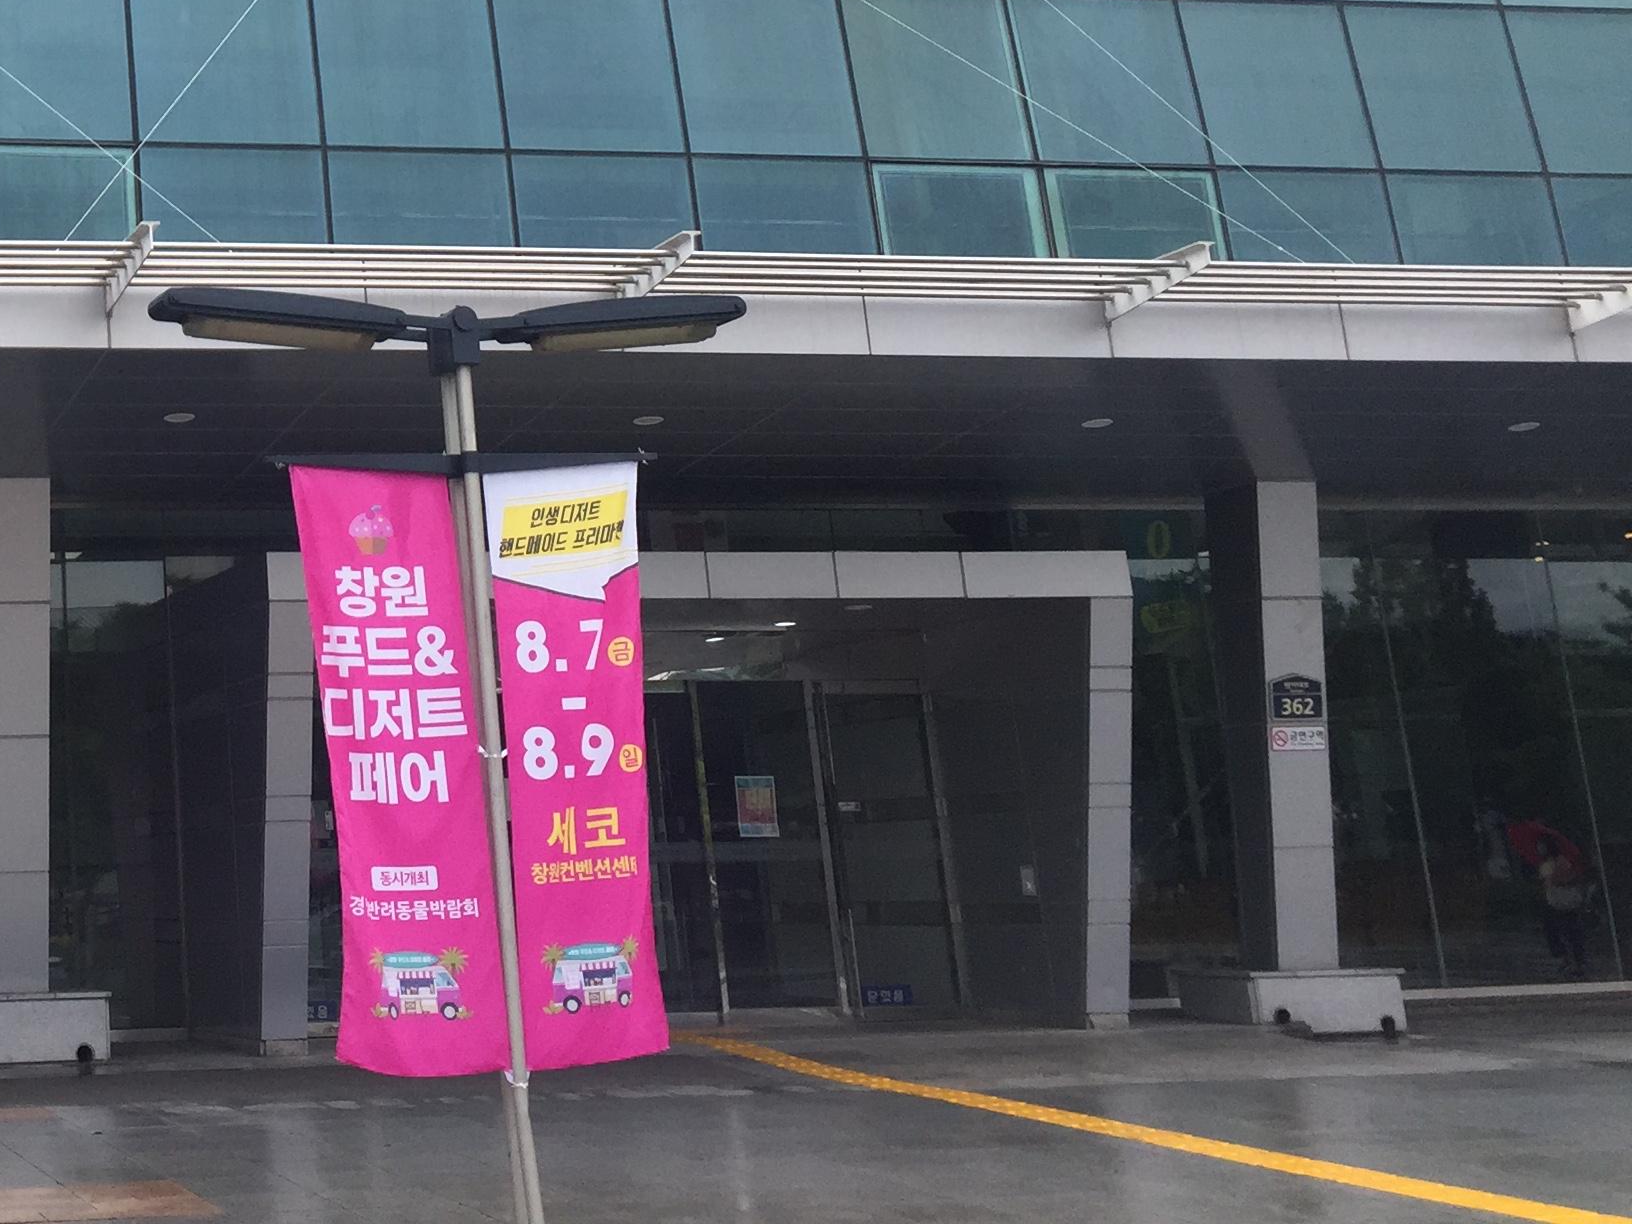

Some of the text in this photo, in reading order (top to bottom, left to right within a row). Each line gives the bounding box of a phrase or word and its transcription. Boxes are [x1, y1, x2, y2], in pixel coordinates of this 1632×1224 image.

[499, 531, 569, 559] 핸드메이드
[334, 565, 429, 618] 창원
[320, 624, 459, 677] 푸드&
[514, 619, 632, 674] 8.7 금
[324, 687, 468, 741] 디저트
[1281, 698, 1315, 716] 362
[349, 749, 451, 805] 페어
[522, 722, 641, 782] 8.9 일
[547, 805, 627, 856] 세코
[379, 870, 430, 886] 동시개최
[530, 855, 639, 885] 창원컨벤션센터
